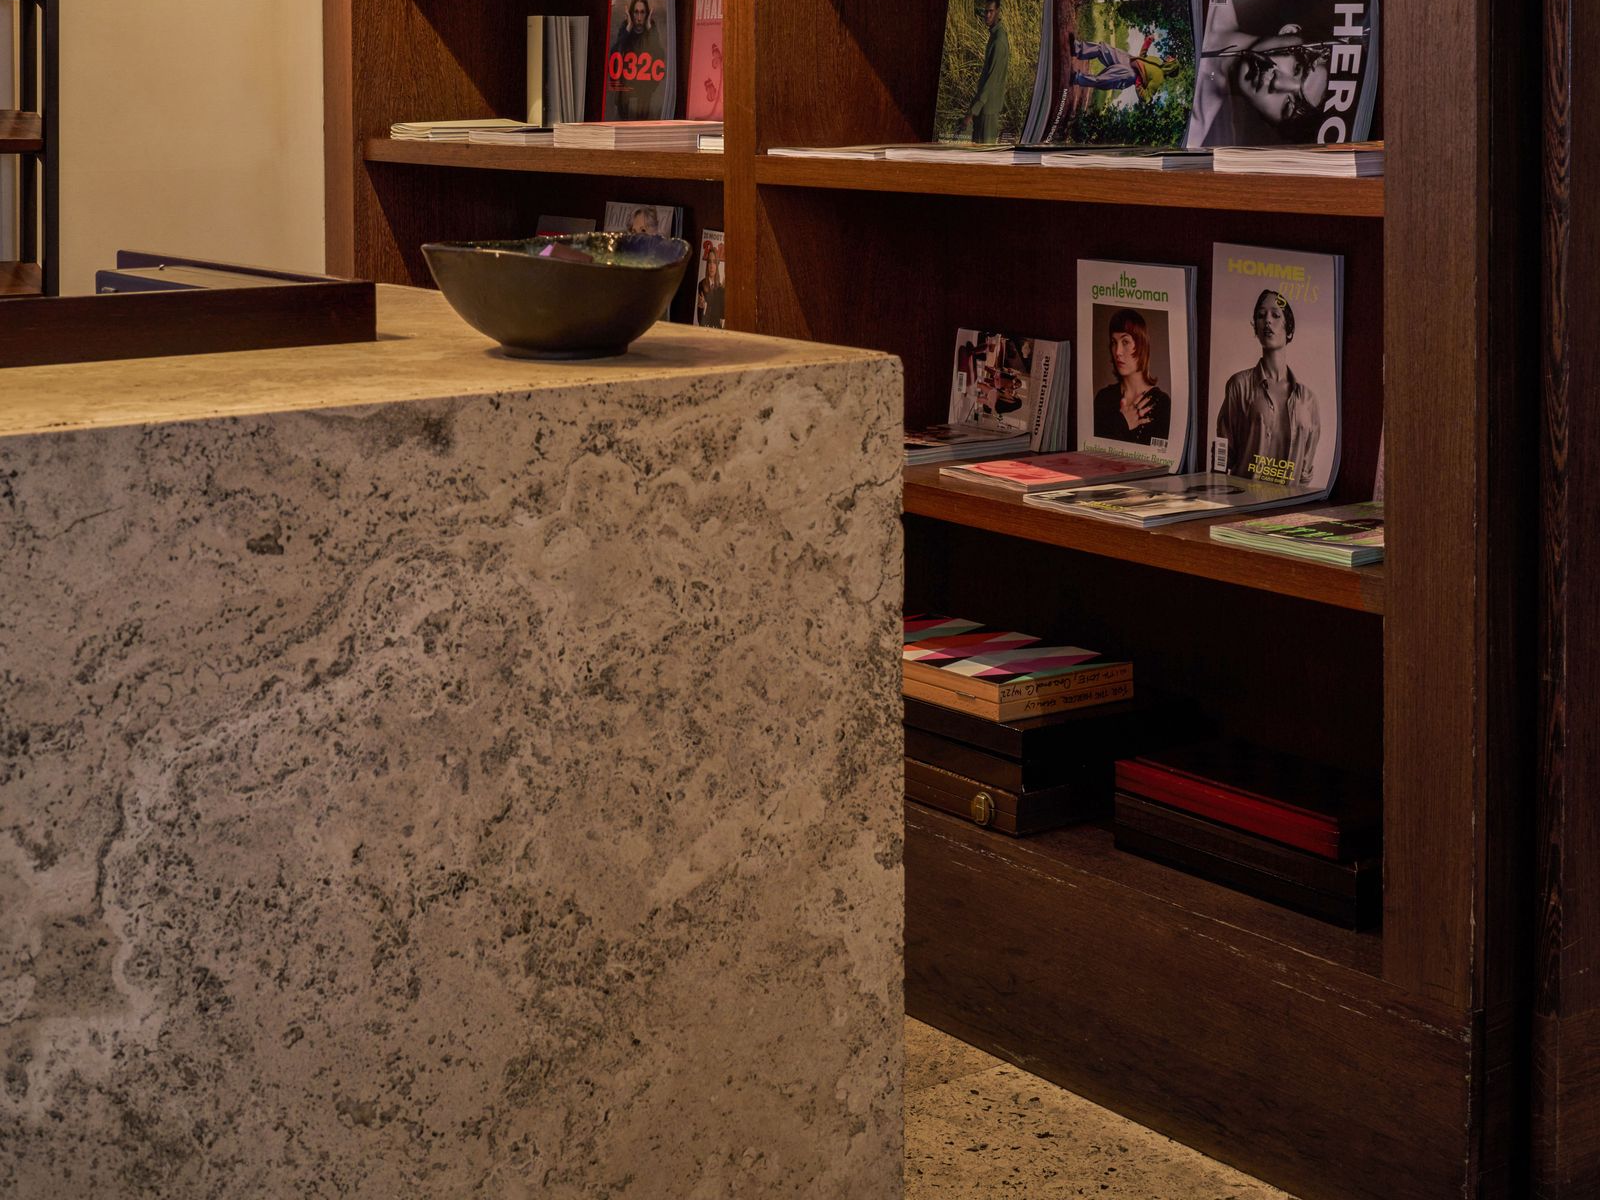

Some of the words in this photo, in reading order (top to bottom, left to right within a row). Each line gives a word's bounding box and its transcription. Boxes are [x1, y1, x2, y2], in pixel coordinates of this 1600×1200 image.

[608, 50, 666, 82] 032c
[1119, 270, 1137, 288] the
[1228, 257, 1305, 281] HOMME
[1092, 281, 1169, 302] gentlewoman
[1033, 355, 1051, 436] apartamento
[1247, 463, 1295, 481] RUSSELL
[1253, 454, 1295, 471] TAYLOR
